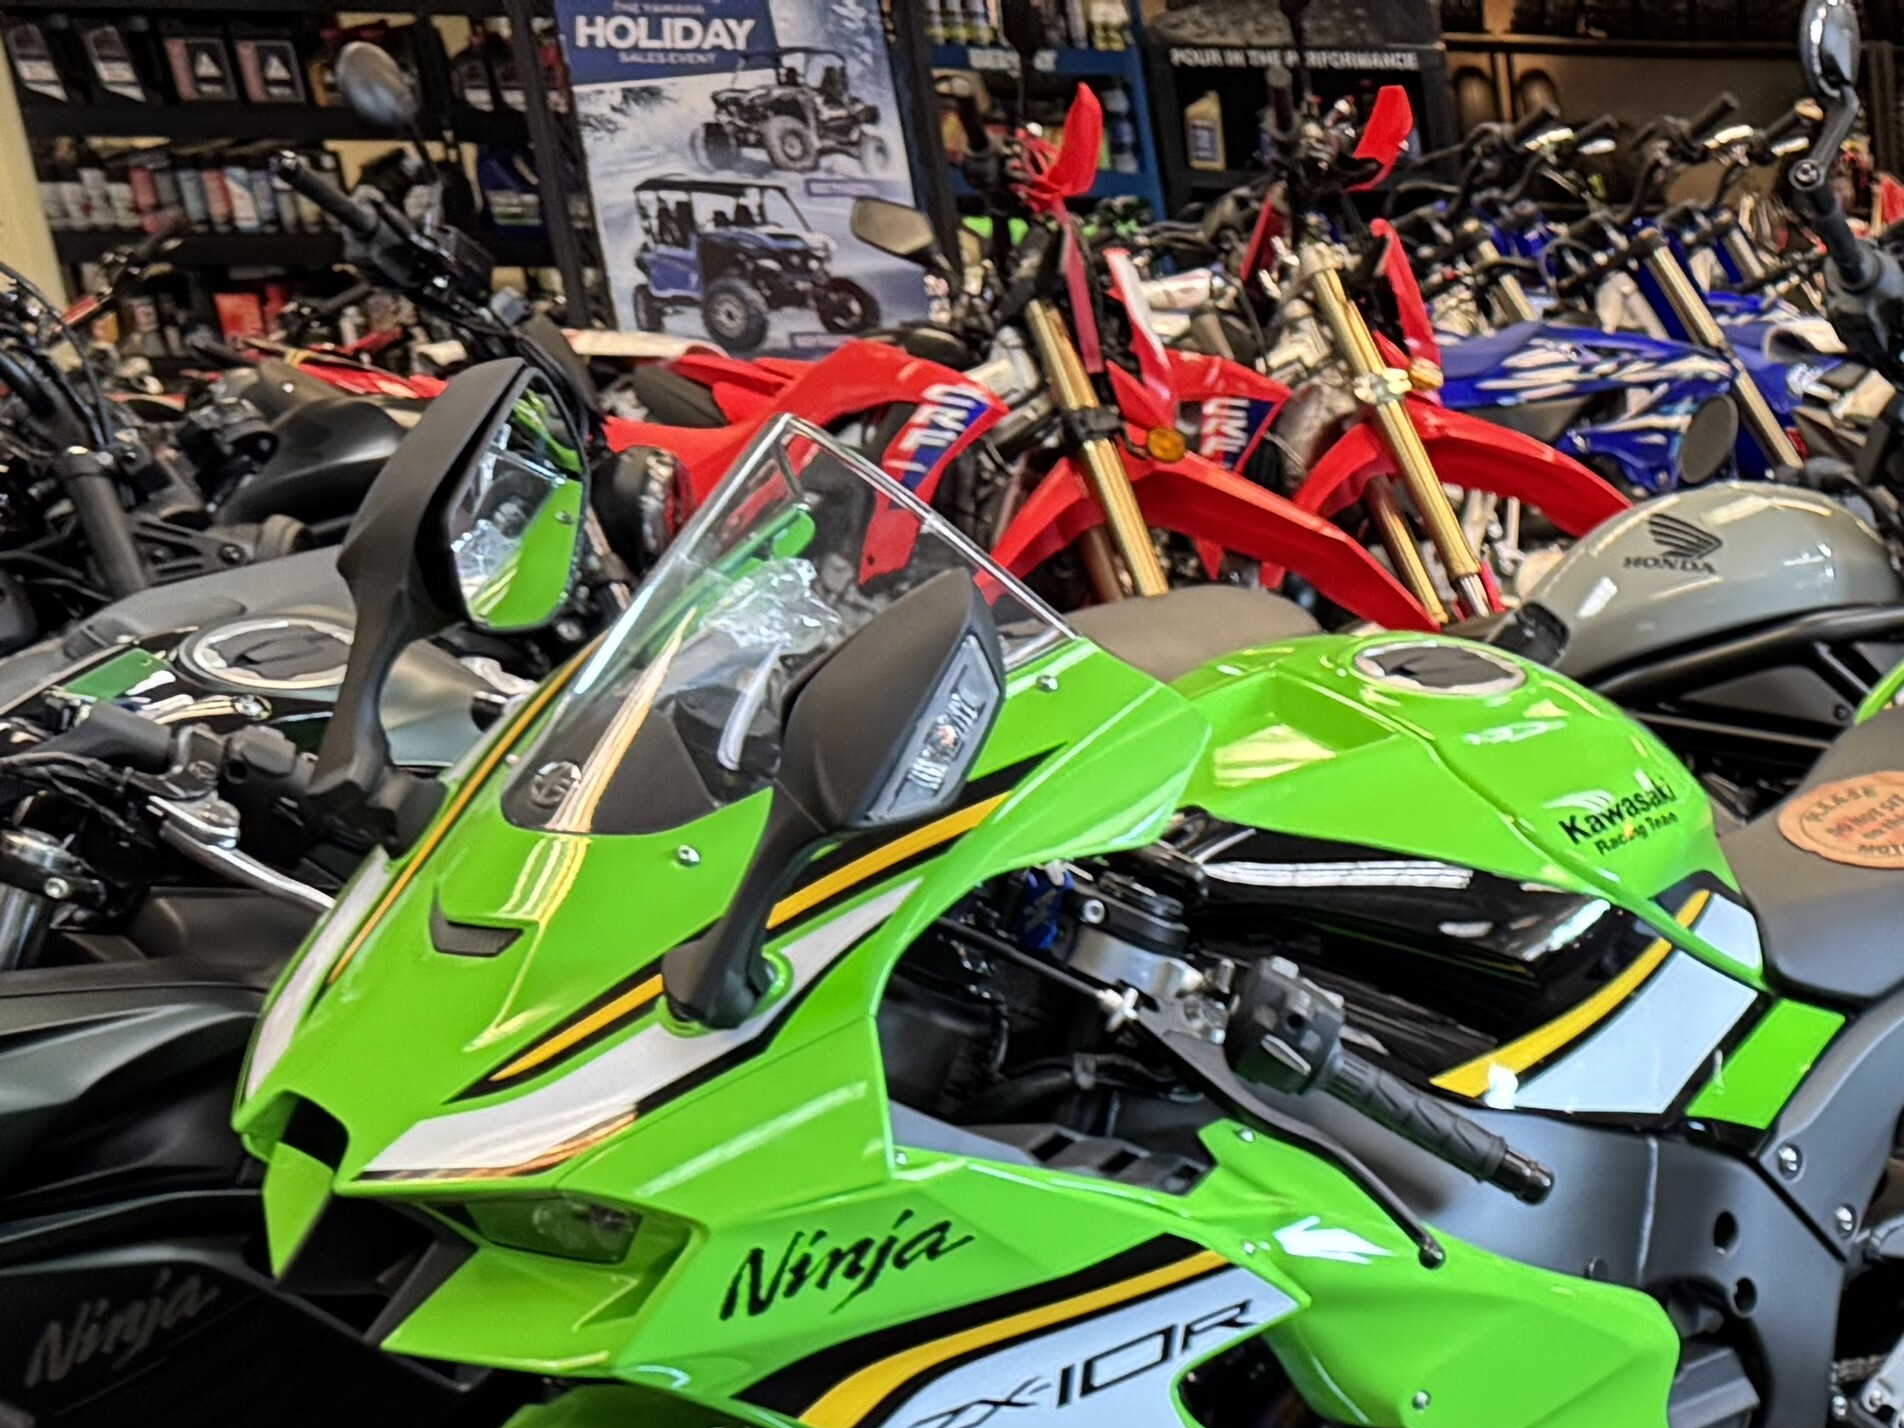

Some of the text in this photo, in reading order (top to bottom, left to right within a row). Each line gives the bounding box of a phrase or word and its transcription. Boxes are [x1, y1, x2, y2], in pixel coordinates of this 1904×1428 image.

[575, 14, 756, 51] HOLIDAY
[1170, 48, 1419, 71] POUR IN THE PRFORMANCE
[1622, 555, 1718, 575] HONDA
[1558, 776, 1678, 846] Kawasaki
[720, 1208, 975, 1322] Ninja
[24, 1266, 222, 1390] Ninja
